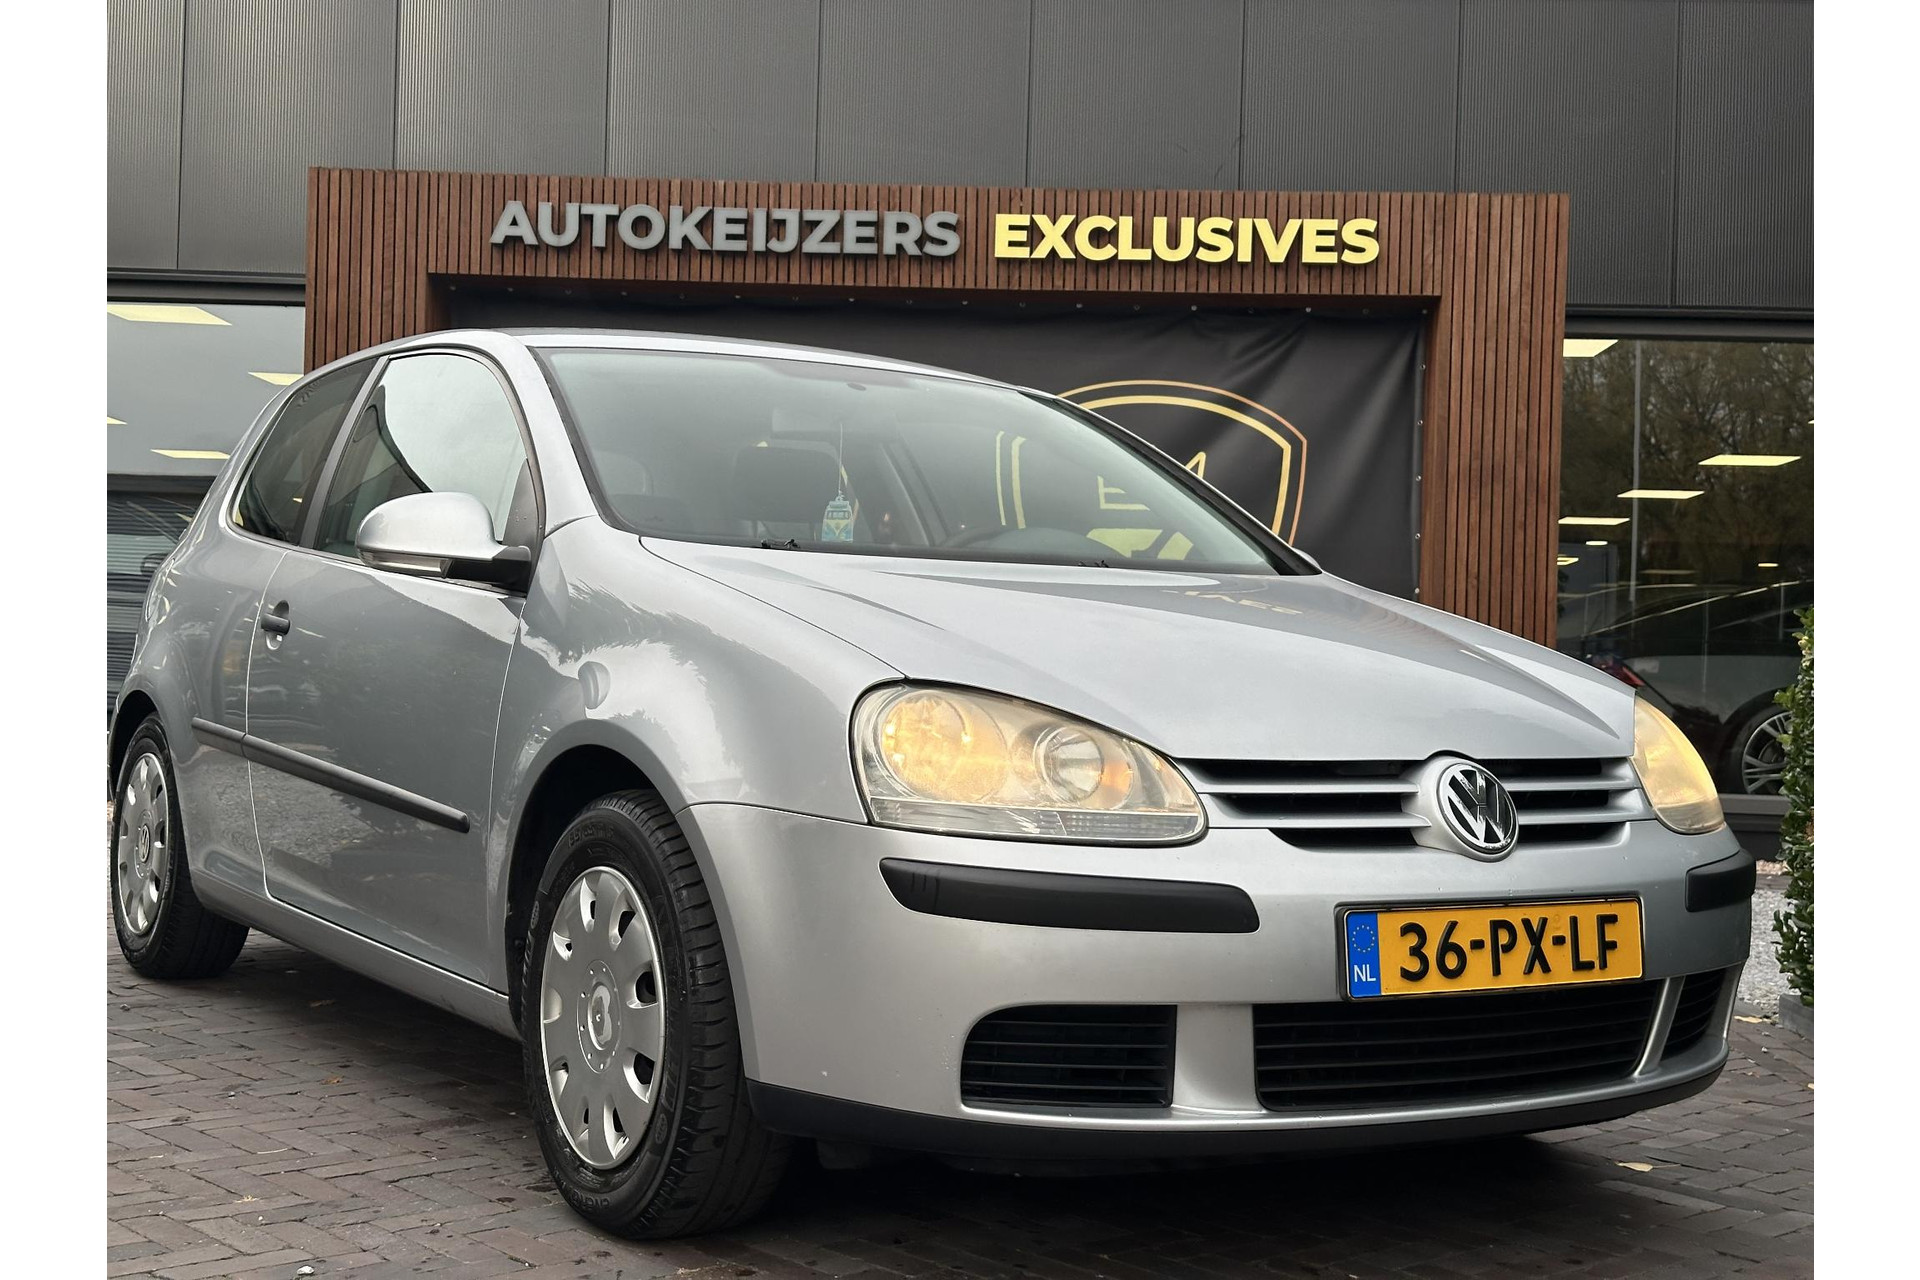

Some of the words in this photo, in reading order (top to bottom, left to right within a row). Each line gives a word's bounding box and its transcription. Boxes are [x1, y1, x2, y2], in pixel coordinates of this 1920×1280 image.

[489, 199, 961, 258] AUTOKEIJZERS
[994, 213, 1380, 265] EXCLUSIVES
[1353, 963, 1377, 983] NL
[1399, 913, 1619, 982] 36-PX-LF
